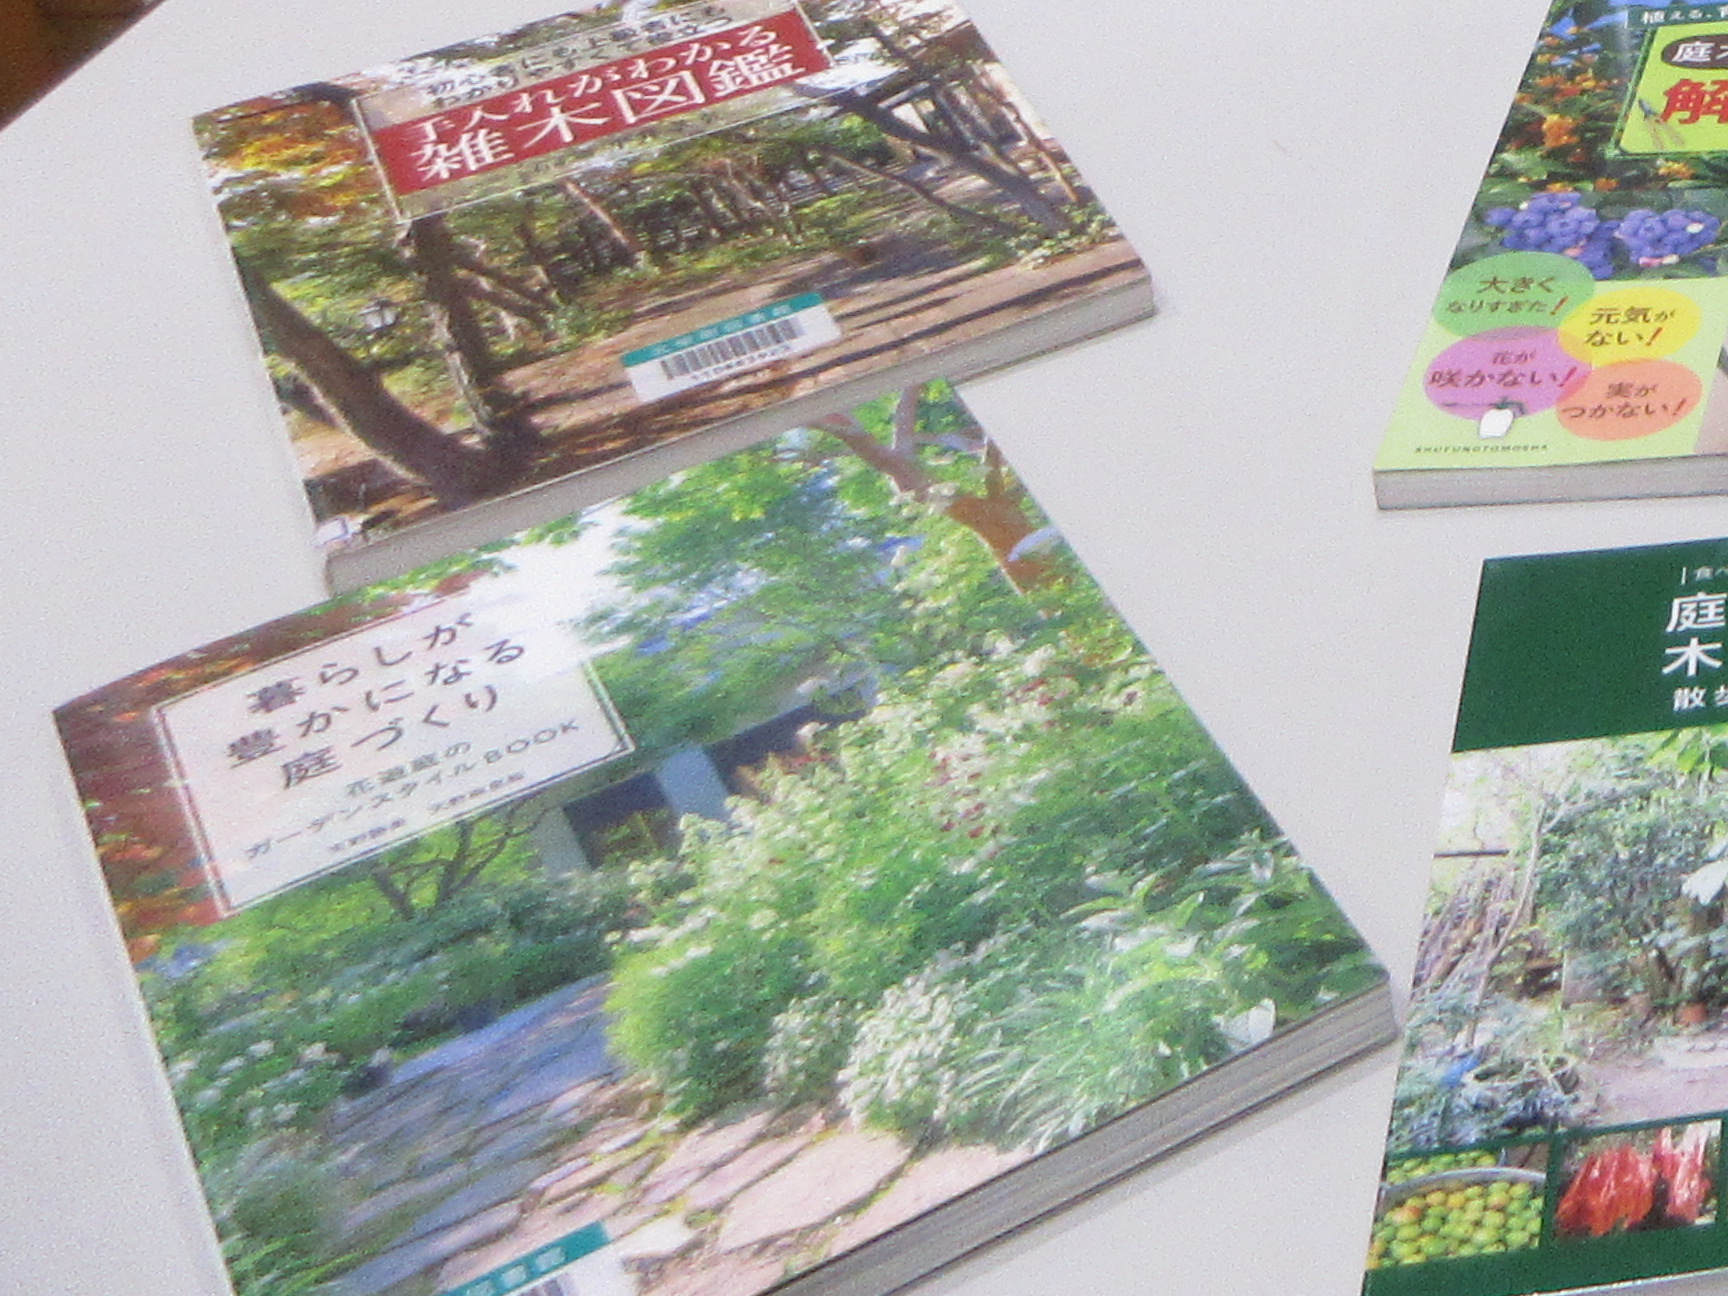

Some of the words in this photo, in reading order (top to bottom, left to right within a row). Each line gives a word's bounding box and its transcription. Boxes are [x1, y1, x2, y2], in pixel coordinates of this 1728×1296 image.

[410, 42, 807, 180] 雑木図鑑
[1477, 275, 1556, 295] 大きく
[1590, 306, 1677, 326] 元気が
[1584, 327, 1664, 347] ない!
[1491, 350, 1538, 364] 花が
[1427, 366, 1578, 389] 咲かない!
[1605, 383, 1657, 399] 実が
[1561, 398, 1687, 419] つかない!
[245, 614, 474, 713] 暮らしが
[226, 638, 526, 766] 豊かになる
[281, 684, 499, 789] 庭づくり
